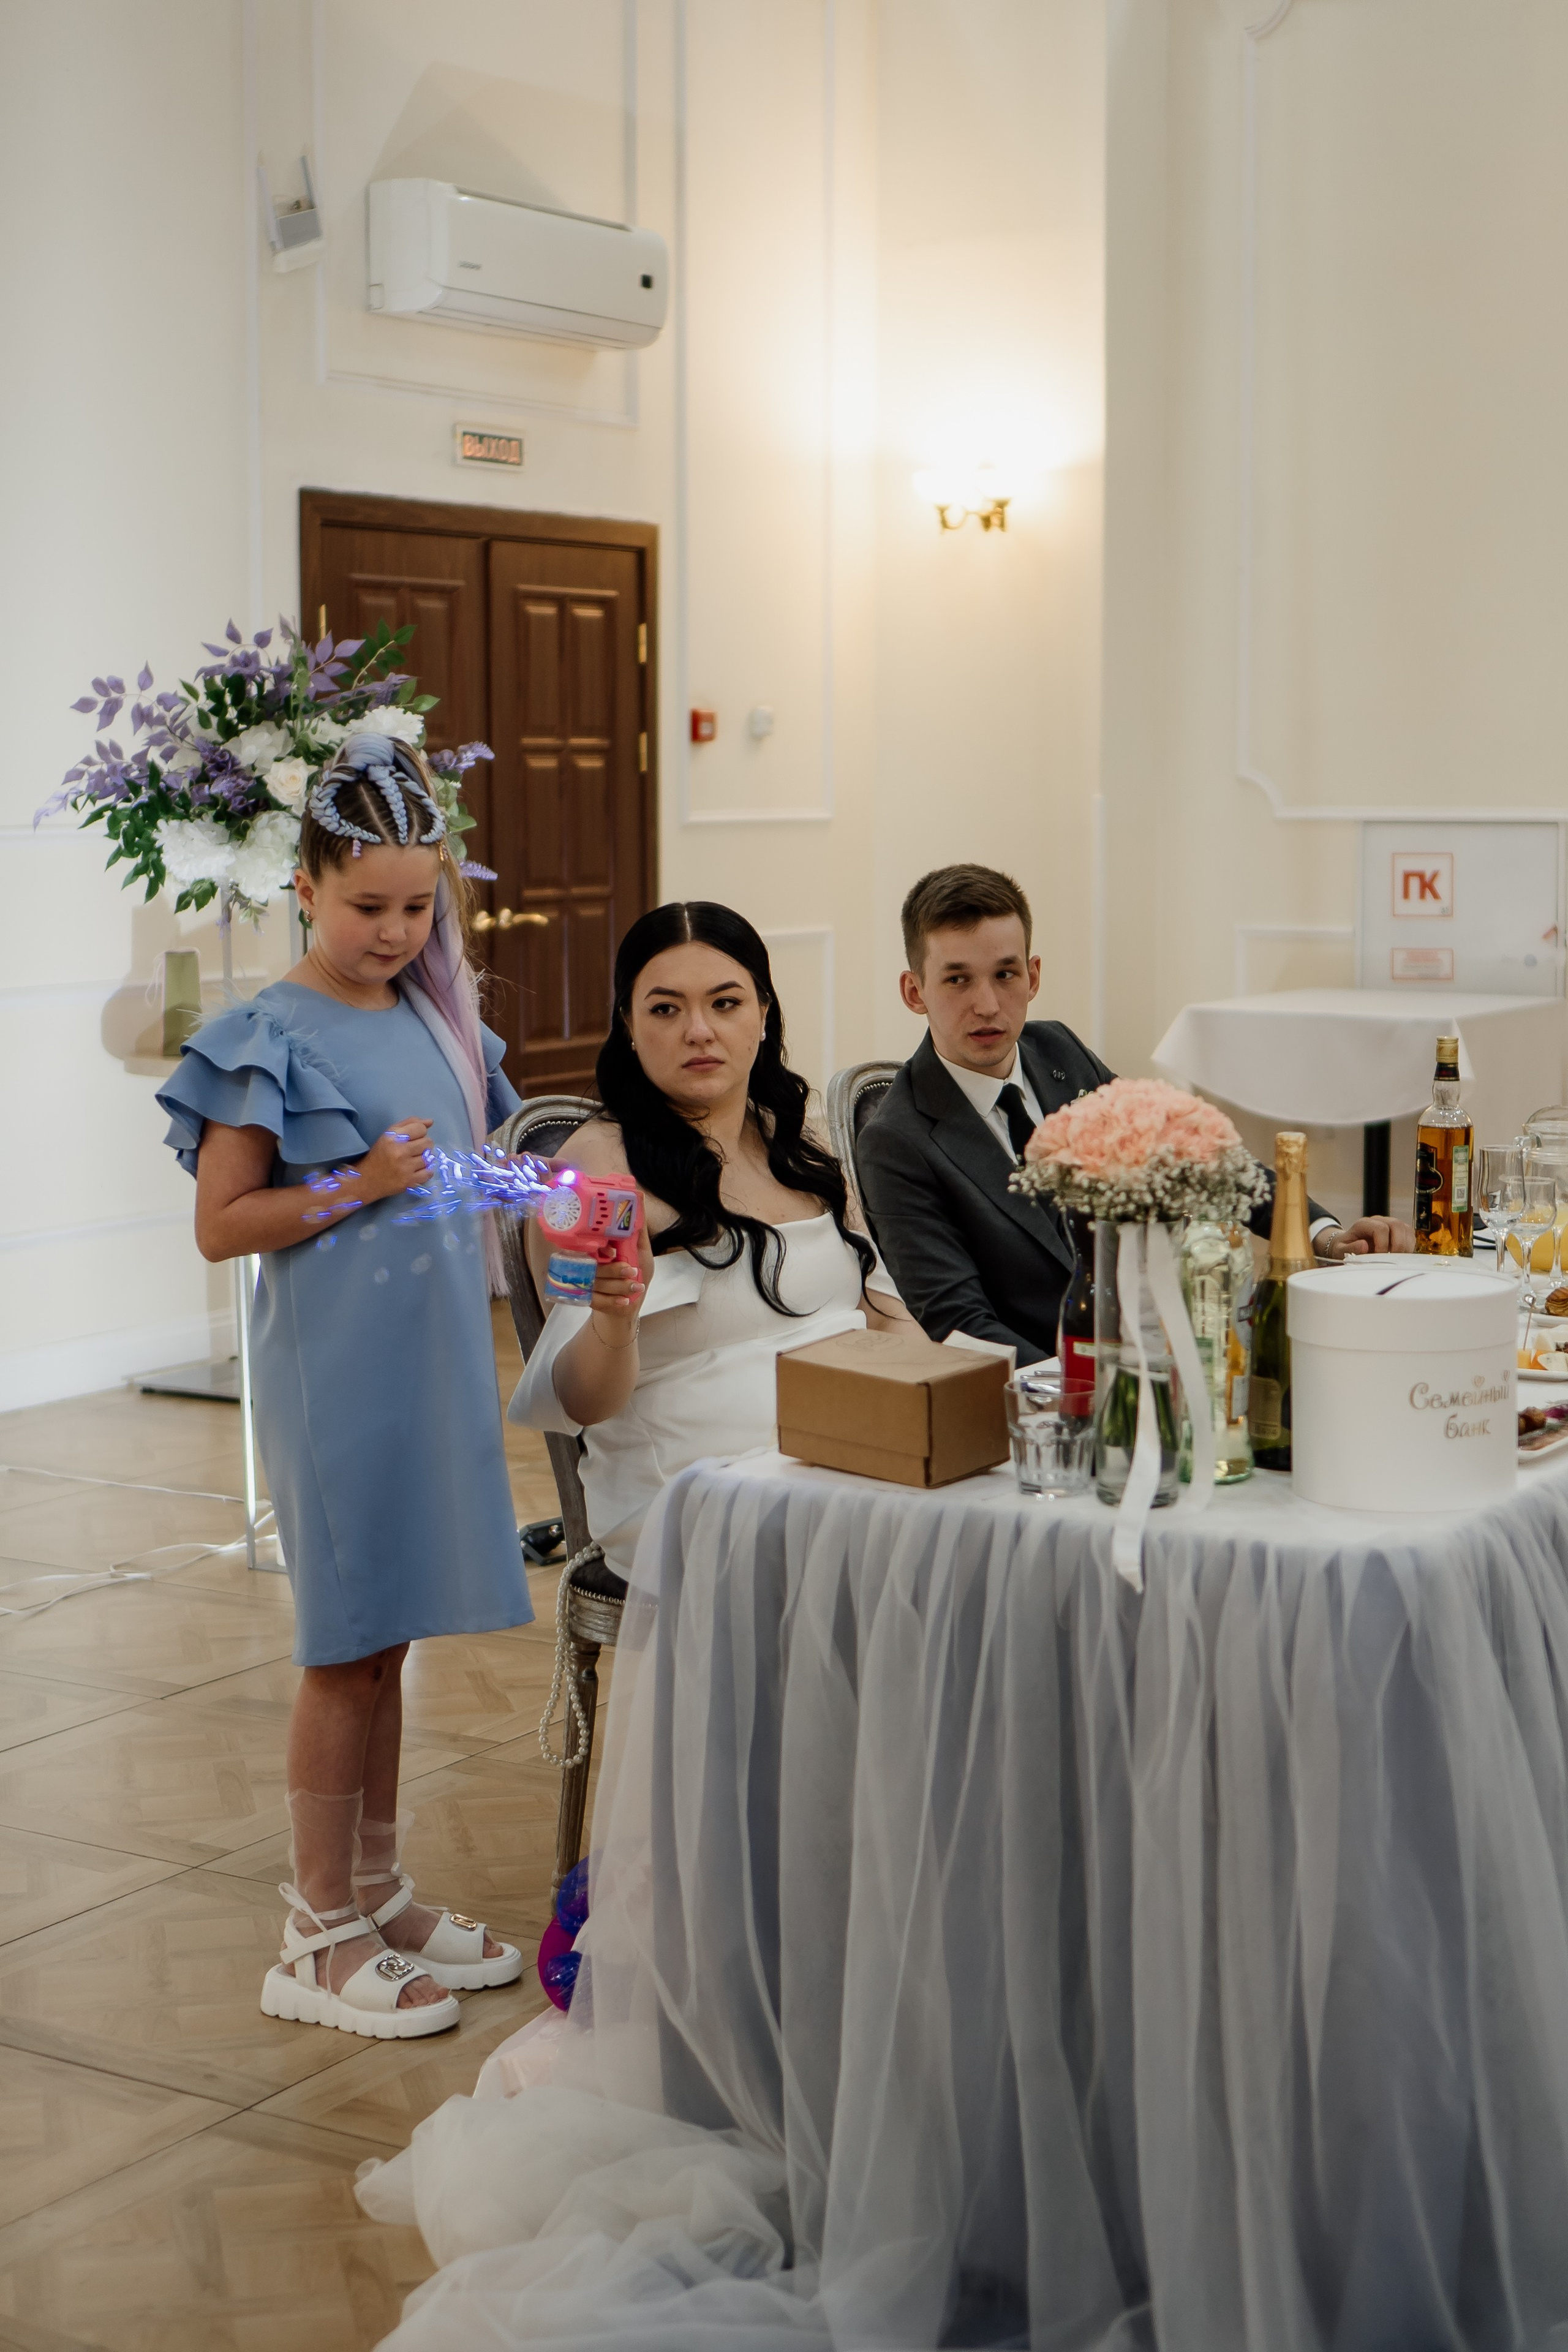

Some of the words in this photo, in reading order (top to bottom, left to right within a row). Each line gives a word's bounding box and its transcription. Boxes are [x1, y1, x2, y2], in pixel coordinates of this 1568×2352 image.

[463, 434, 521, 464] ВЫХОД
[1403, 870, 1442, 900] ПК
[1444, 1413, 1491, 1439] банк
